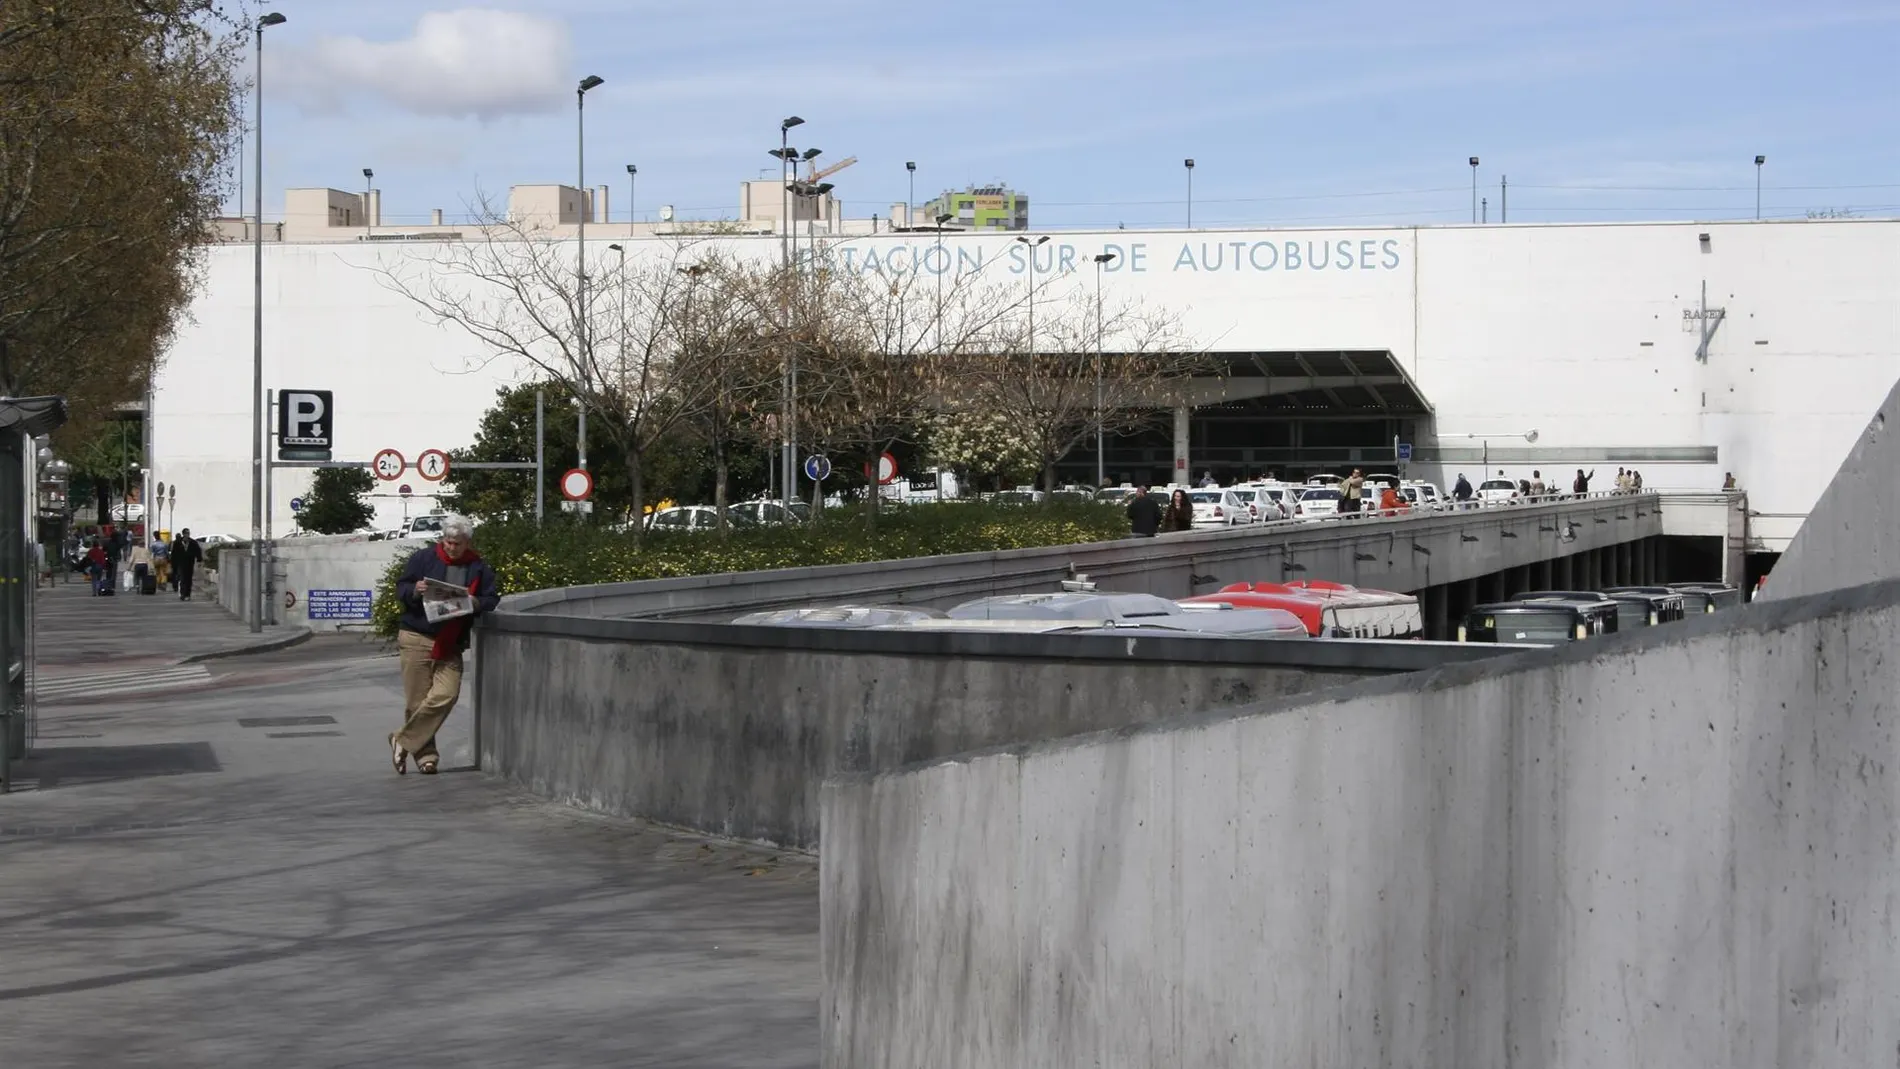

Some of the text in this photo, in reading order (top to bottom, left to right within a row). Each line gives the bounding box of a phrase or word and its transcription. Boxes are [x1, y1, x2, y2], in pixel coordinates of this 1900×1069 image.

[1008, 244, 1077, 274] SUR
[1103, 243, 1147, 273] DE
[1173, 239, 1400, 273] AUTOBUSES
[288, 392, 325, 437] P
